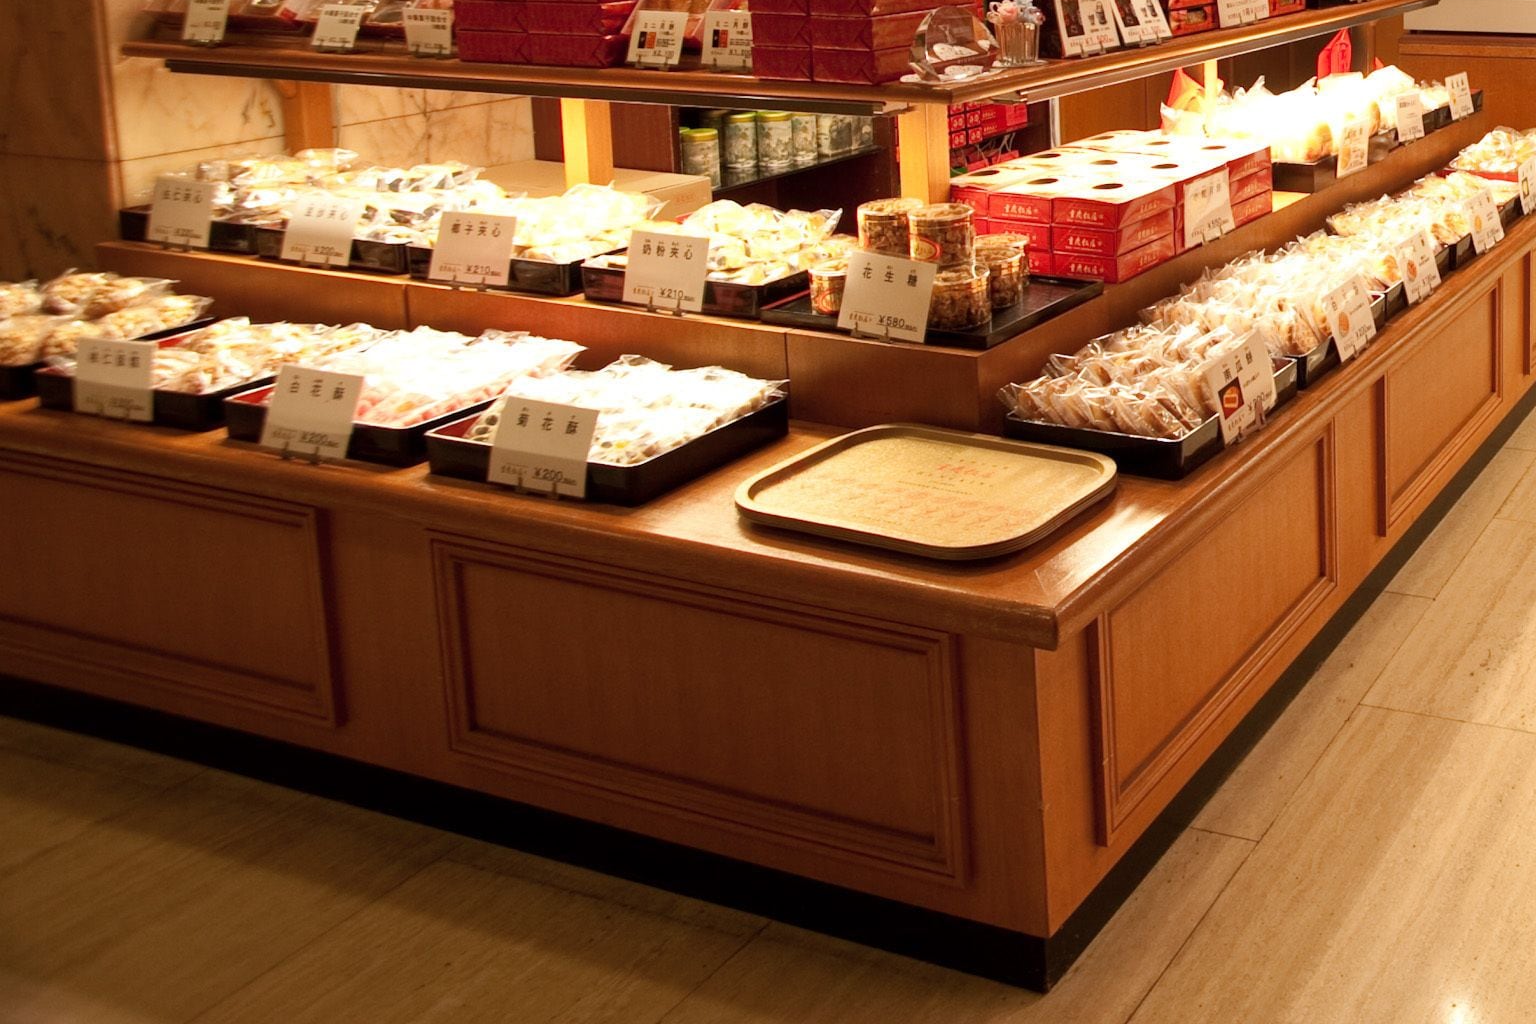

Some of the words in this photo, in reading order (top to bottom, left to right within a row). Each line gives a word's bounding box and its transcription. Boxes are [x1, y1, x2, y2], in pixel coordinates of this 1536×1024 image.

[642, 242, 694, 261] 奶粉夾心
[465, 264, 492, 275] ¥210
[659, 288, 684, 300] ¥210
[878, 315, 906, 327] ¥580
[533, 467, 564, 480] ¥200
